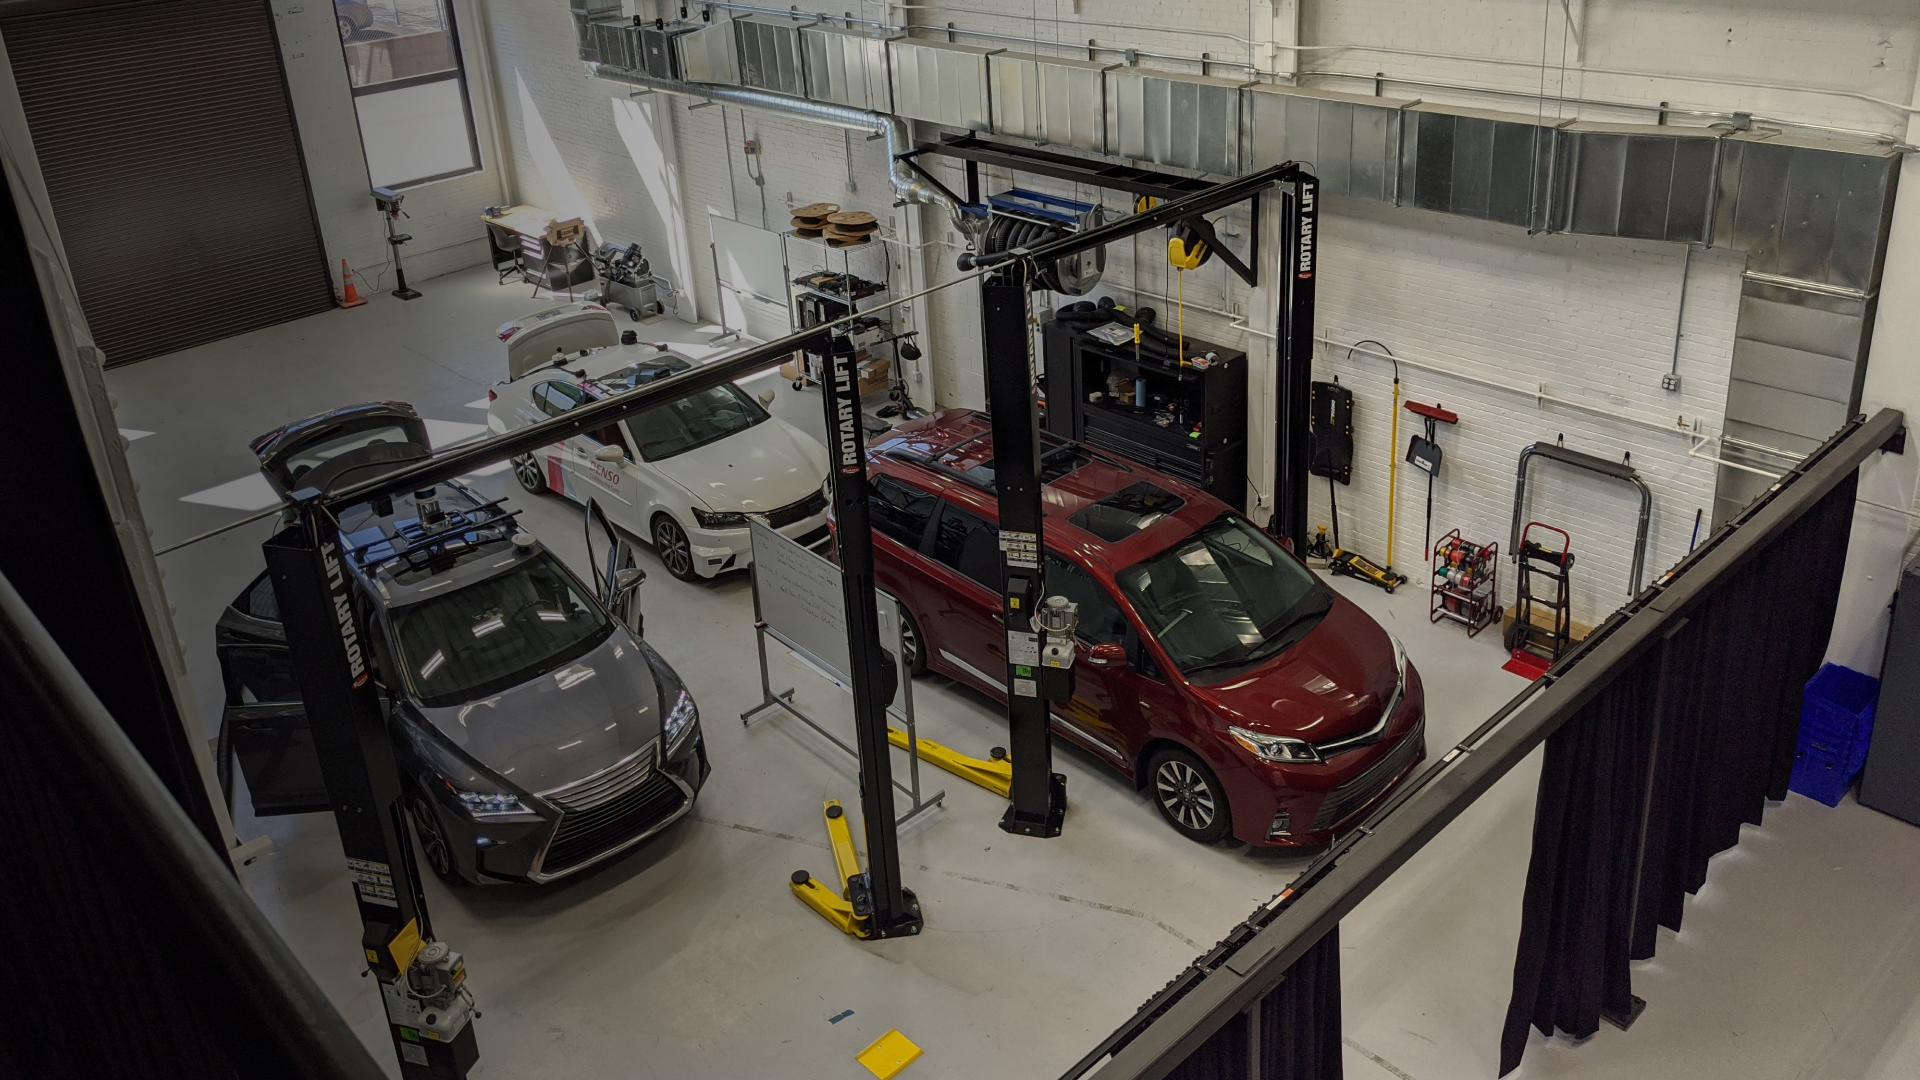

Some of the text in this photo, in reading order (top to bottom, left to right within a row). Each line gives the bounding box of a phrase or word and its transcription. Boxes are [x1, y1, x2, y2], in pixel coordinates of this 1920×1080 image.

[1300, 183, 1314, 272] ROTARY LIFT
[832, 356, 858, 466] ROTARY LIFT
[589, 460, 620, 485] DENSO
[320, 542, 365, 679] ROTARY LIFT
